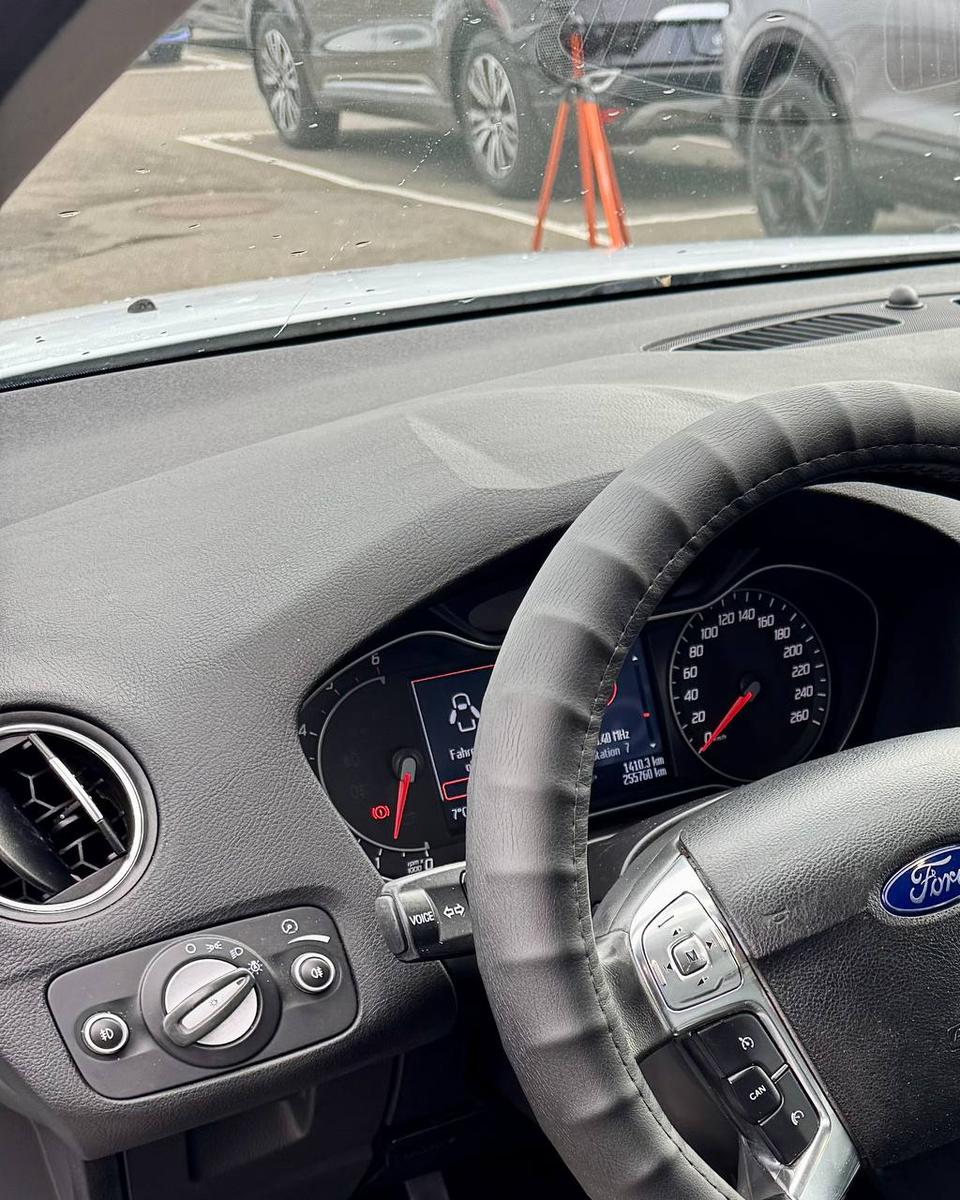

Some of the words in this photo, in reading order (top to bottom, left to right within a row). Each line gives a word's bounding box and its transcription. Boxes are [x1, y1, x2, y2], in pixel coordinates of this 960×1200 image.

[718, 612, 734, 626] 120
[738, 608, 755, 622] 140
[757, 614, 775, 629] 160
[700, 626, 718, 640] 100
[774, 627, 791, 641] 180
[689, 645, 704, 659] 80
[783, 644, 803, 659] 200
[371, 653, 380, 666] 6
[683, 665, 698, 680] 60
[791, 663, 811, 678] 220
[683, 688, 699, 702] 40
[794, 685, 814, 700] 240
[691, 710, 706, 724] 20
[790, 709, 810, 724] 260
[298, 723, 307, 736] 4
[611, 729, 630, 742] MHz
[594, 747, 621, 761] tation
[623, 757, 651, 774] 1410.3
[651, 756, 665, 767] km
[622, 769, 653, 786] 255760
[654, 767, 667, 778] km
[375, 857, 380, 869] 1
[425, 858, 433, 871] 0
[408, 911, 435, 926] VOICE
[685, 949, 699, 962] M
[749, 1084, 767, 1101] CAN
